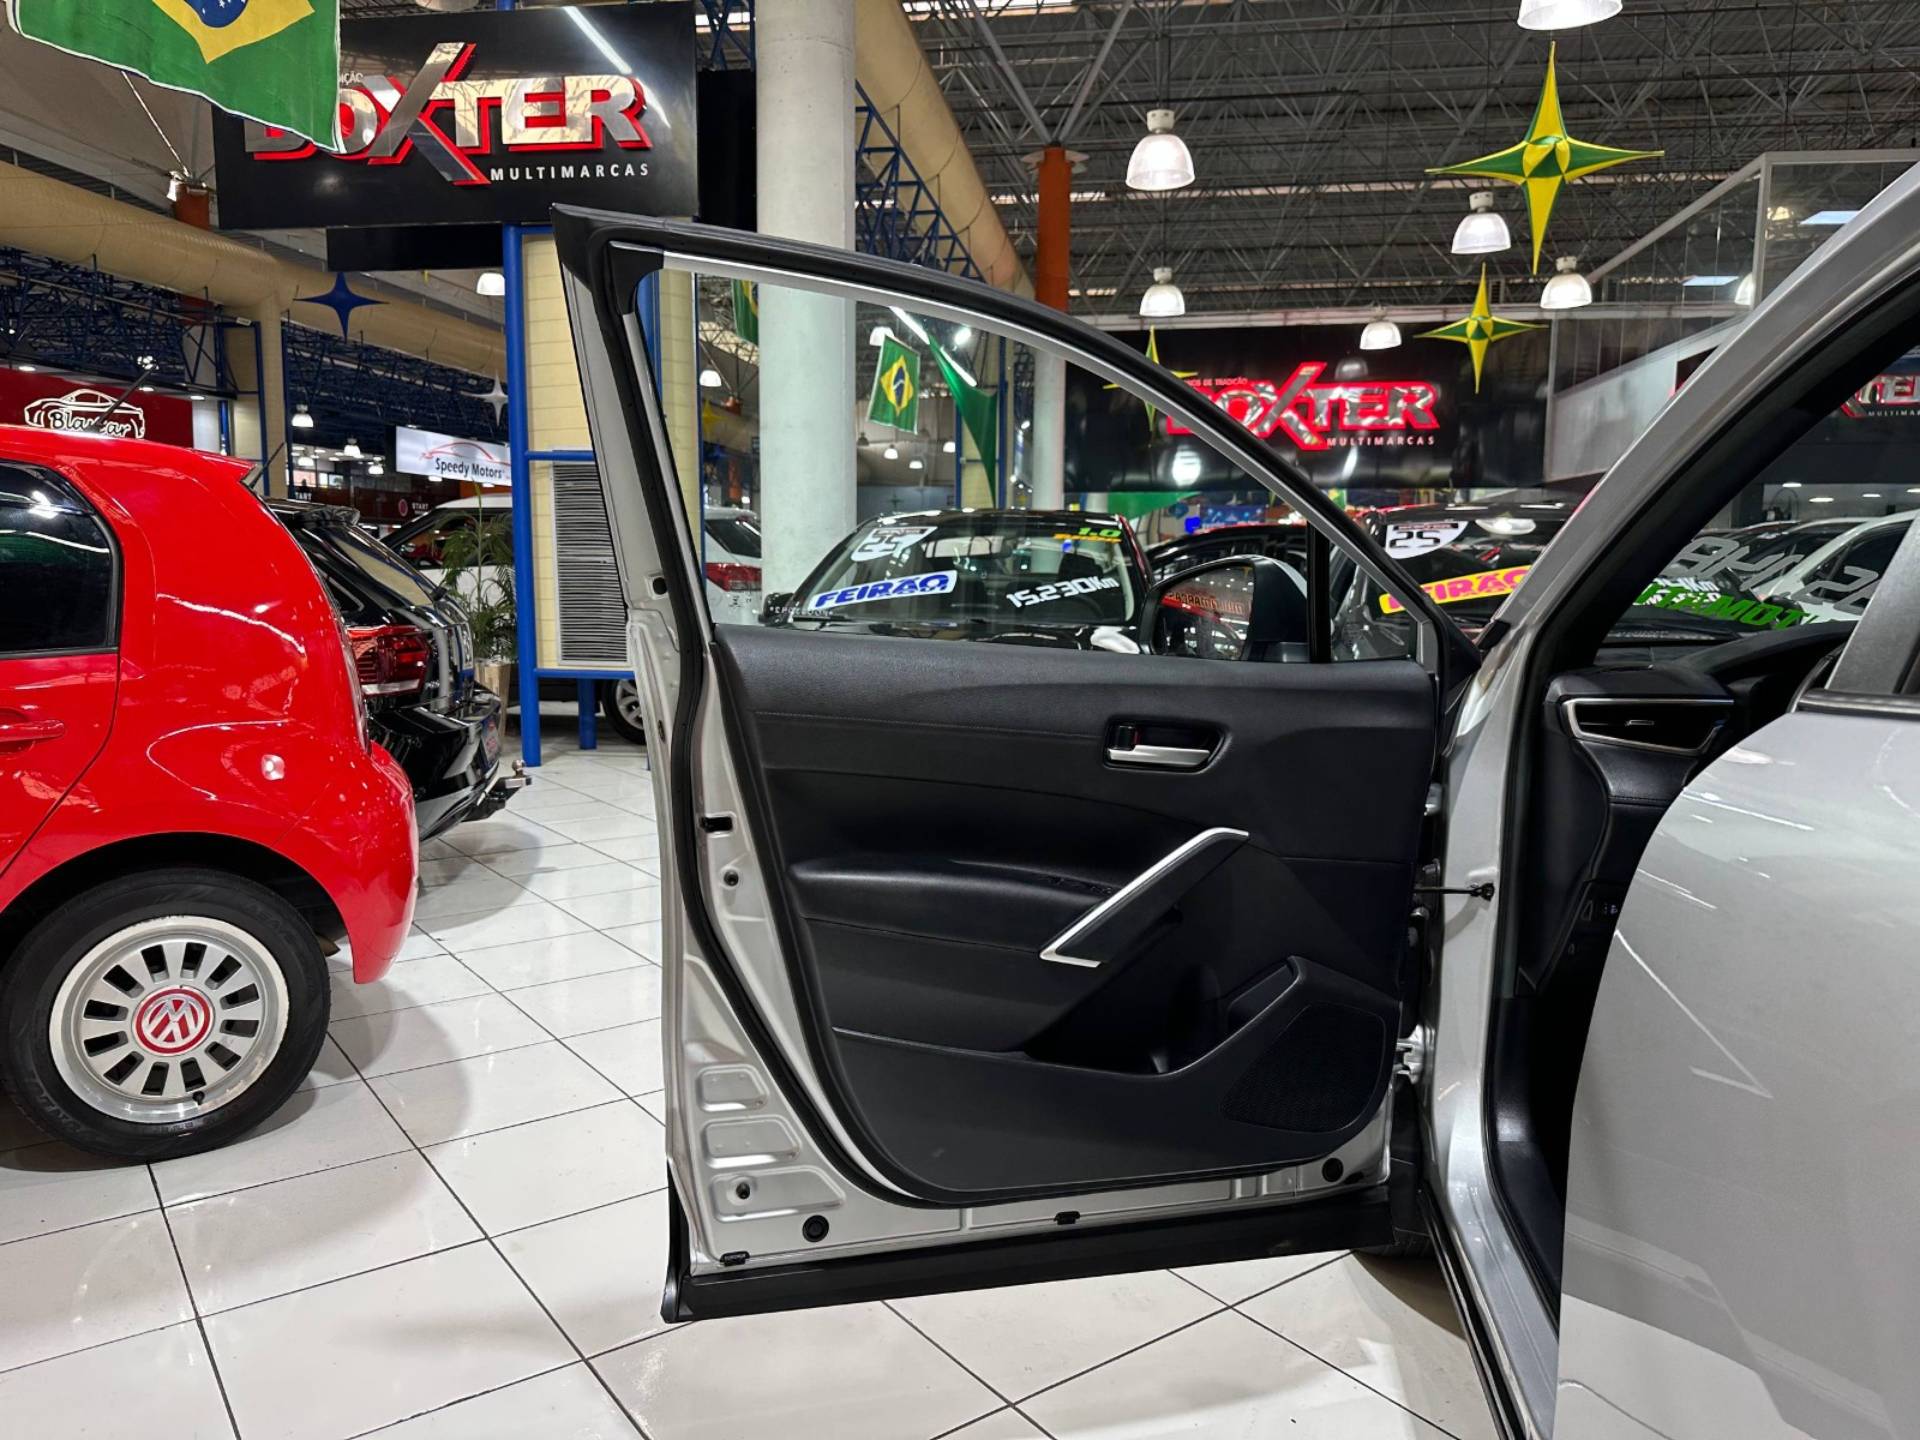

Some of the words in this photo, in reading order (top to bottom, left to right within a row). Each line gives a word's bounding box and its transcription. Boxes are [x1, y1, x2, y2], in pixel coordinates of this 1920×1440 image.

[490, 163, 650, 181] MULTIMARCAS
[1327, 435, 1435, 447] MULTIMARCAS
[435, 457, 470, 477] Speedy
[471, 463, 503, 479] Motors
[1389, 529, 1441, 549] 25
